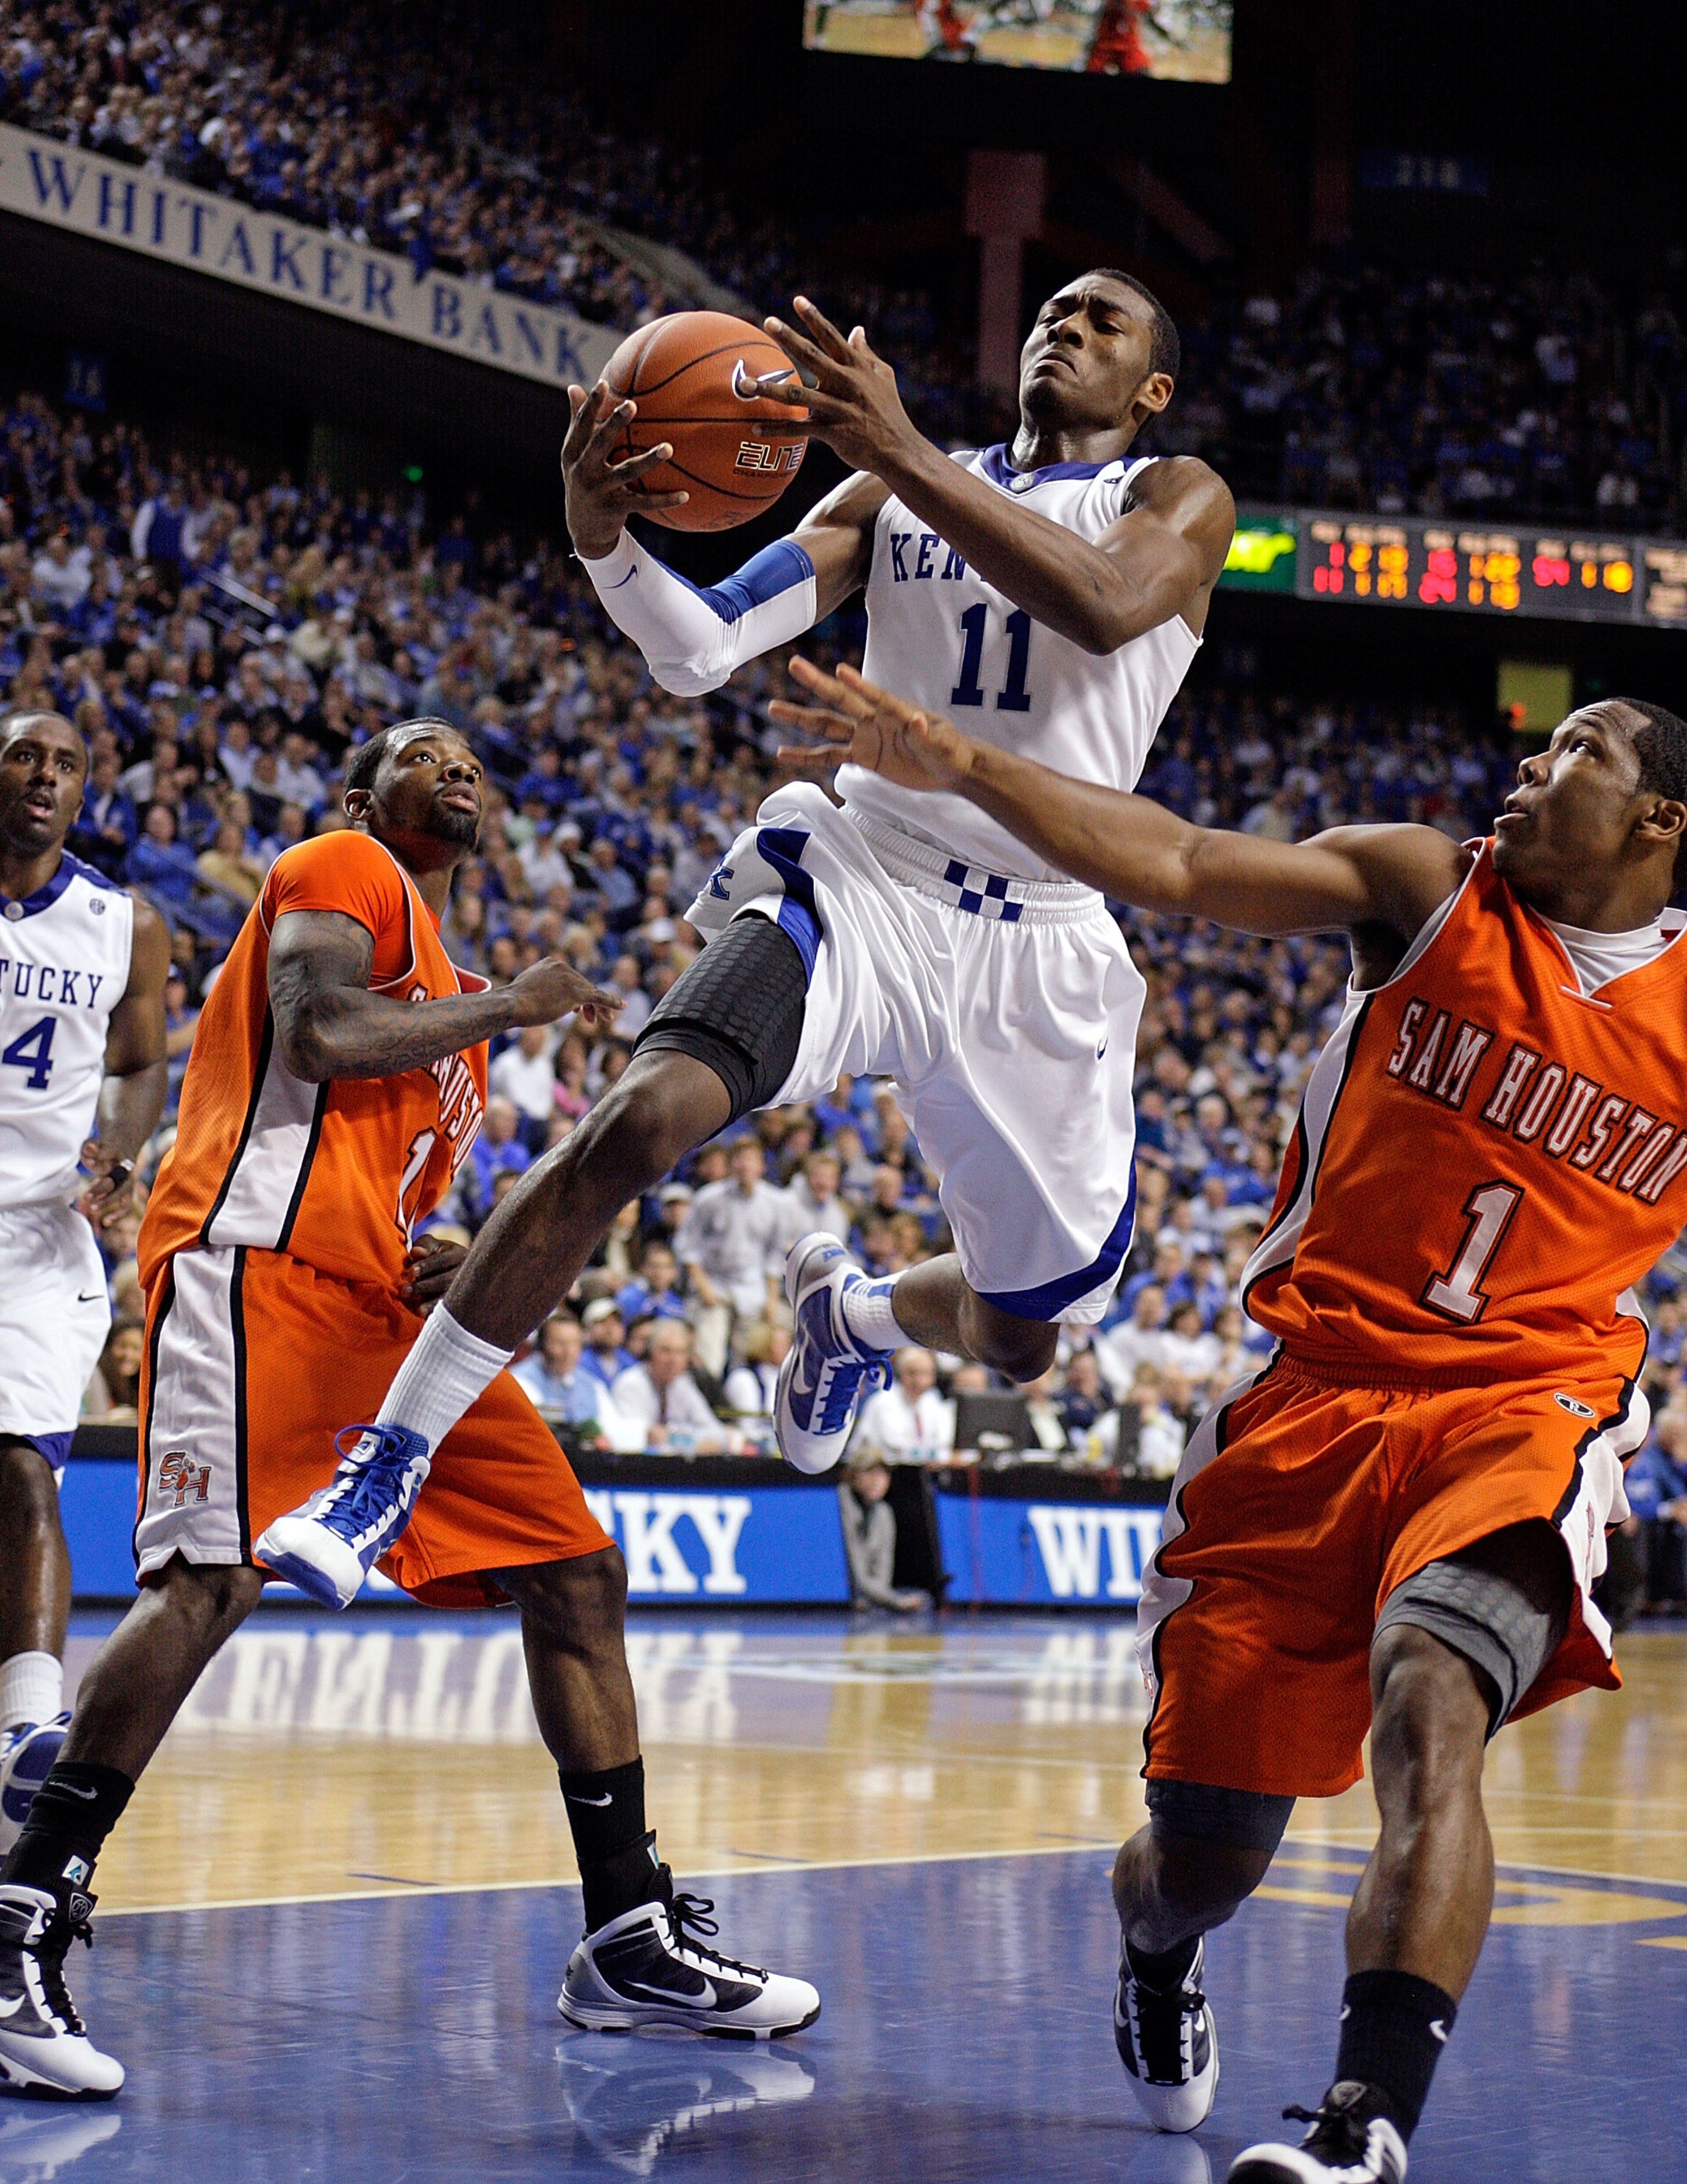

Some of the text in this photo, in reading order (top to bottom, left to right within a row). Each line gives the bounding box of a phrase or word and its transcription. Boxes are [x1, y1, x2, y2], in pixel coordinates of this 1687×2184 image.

[25, 147, 592, 382] WHITAKER BANK
[735, 441, 804, 471] ELITE
[890, 533, 987, 582] KEN
[951, 603, 1031, 711] 11
[1, 1016, 58, 1091] 4
[1386, 997, 1687, 1206] SAM HOUSTON
[1419, 1179, 1525, 1326] 1
